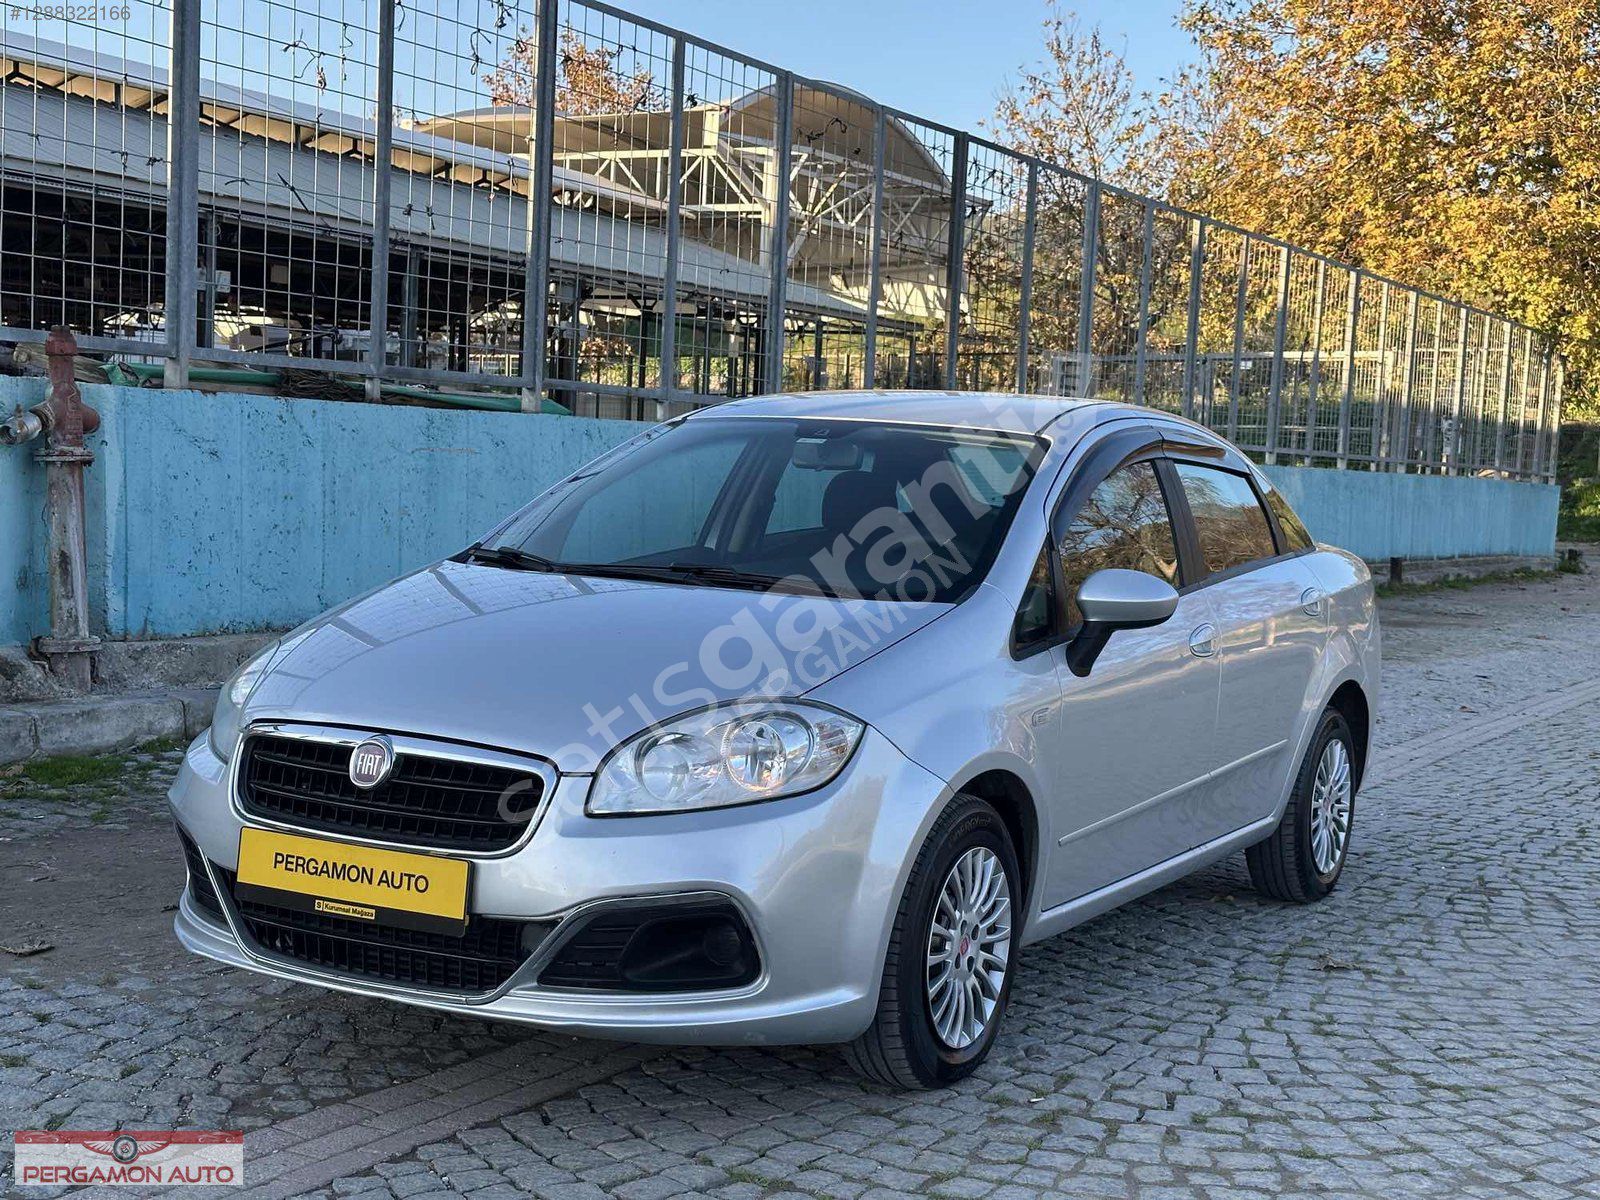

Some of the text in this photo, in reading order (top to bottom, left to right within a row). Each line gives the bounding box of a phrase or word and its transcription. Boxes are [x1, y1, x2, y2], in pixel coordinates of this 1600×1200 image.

[356, 753, 382, 775] FIAT
[273, 852, 429, 893] PERGAMON AUTO
